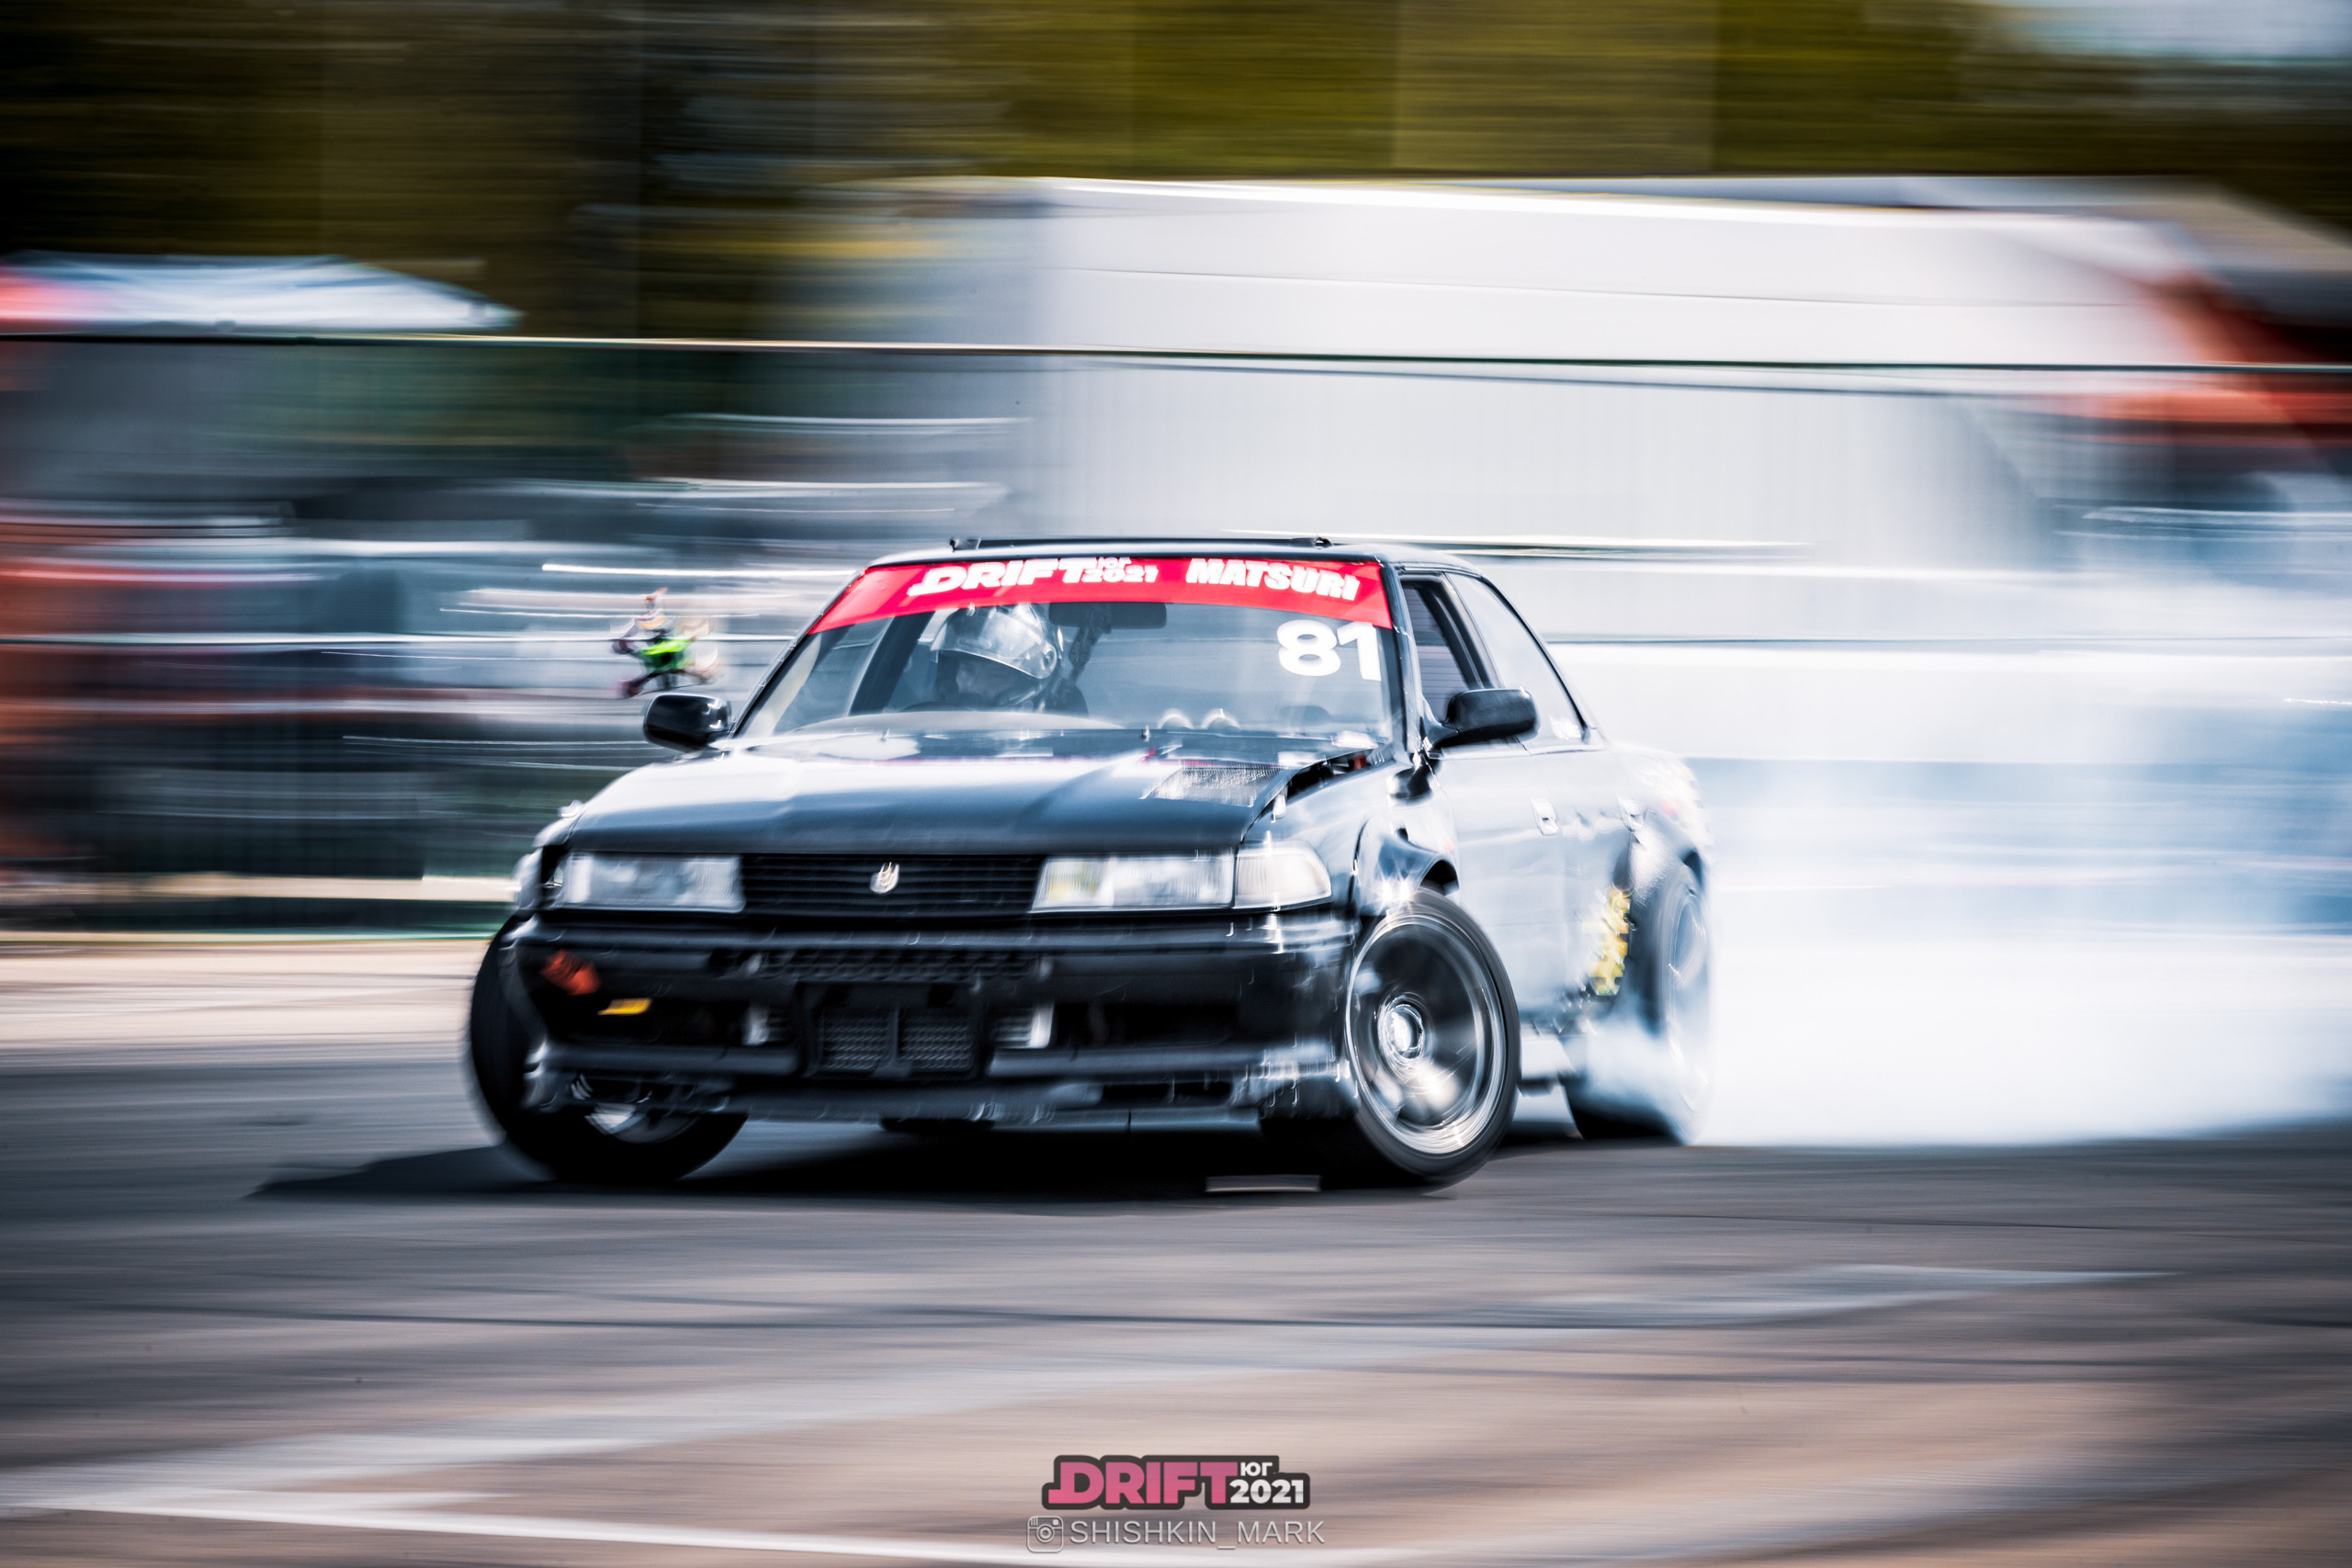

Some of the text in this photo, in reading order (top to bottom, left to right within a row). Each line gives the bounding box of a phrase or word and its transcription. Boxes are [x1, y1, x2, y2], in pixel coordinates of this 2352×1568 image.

[907, 557, 1098, 596] DRIFT
[1081, 565, 1159, 582] 2021
[1186, 558, 1360, 601] MATSURI
[1276, 619, 1381, 681] 81
